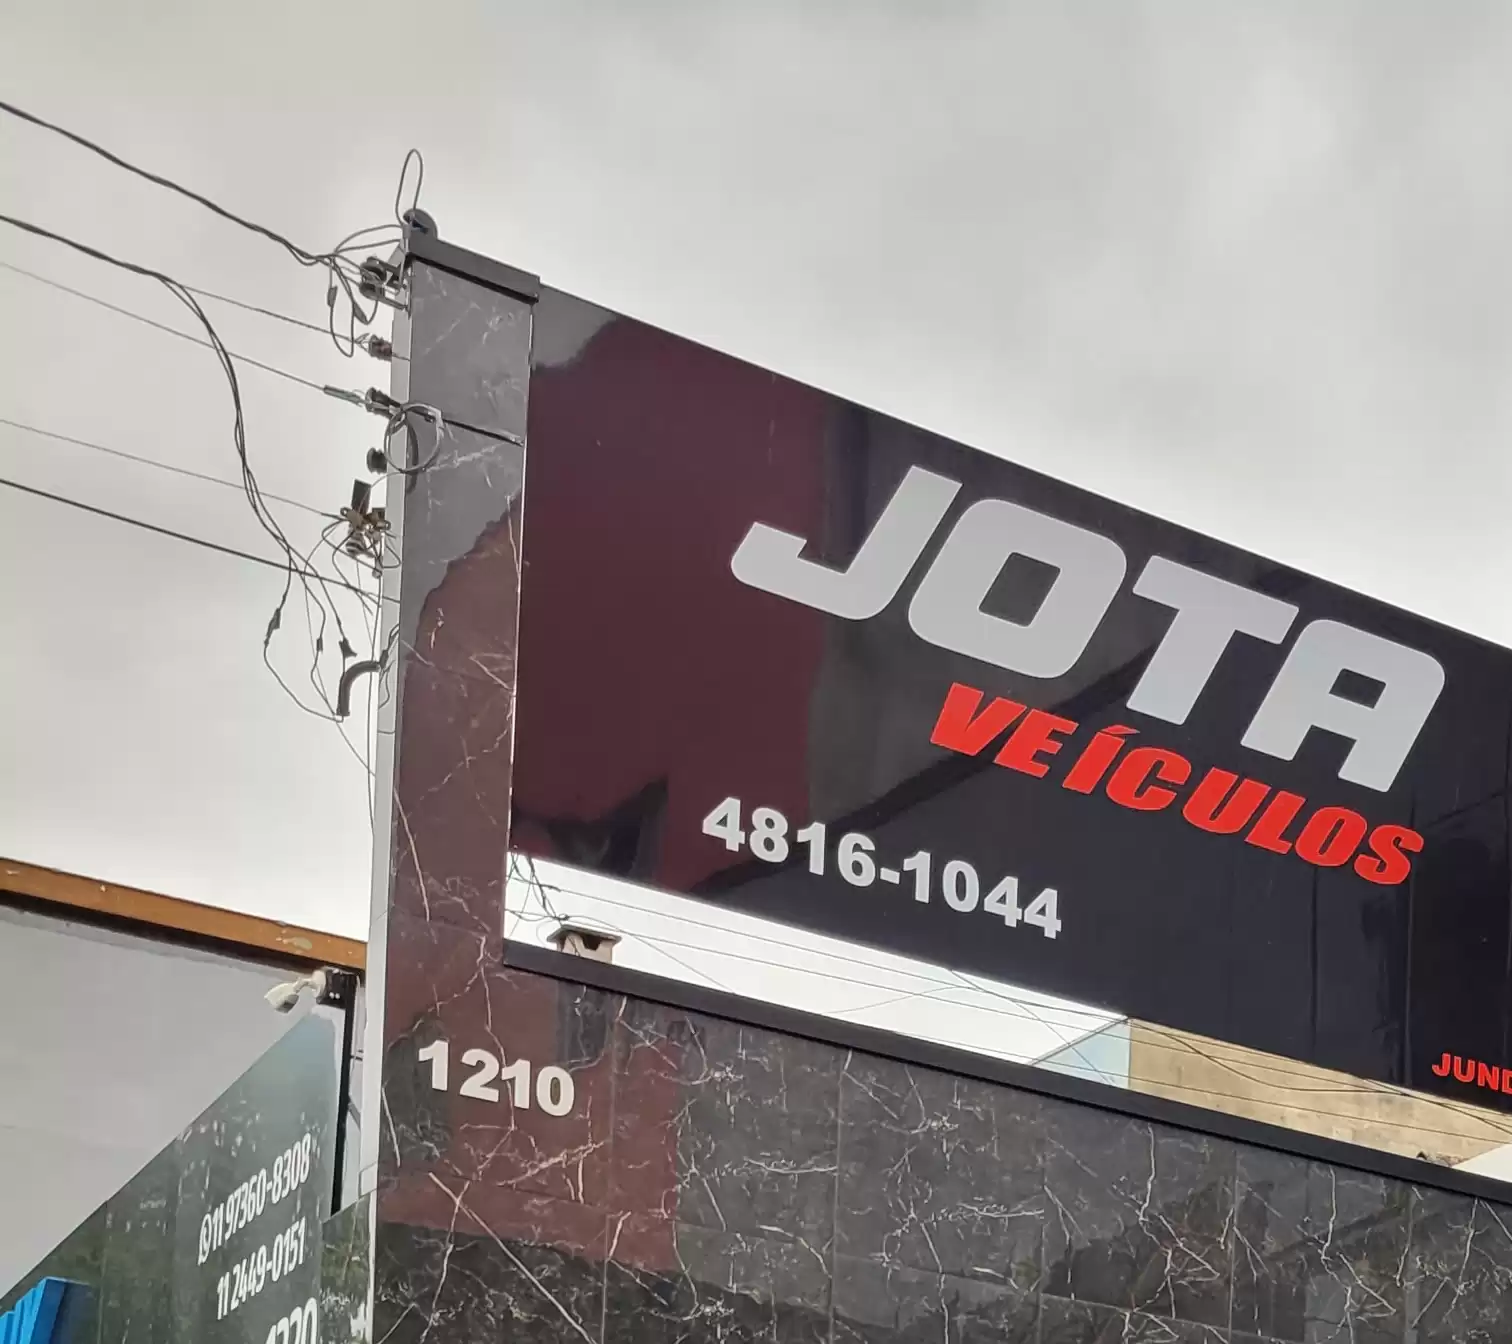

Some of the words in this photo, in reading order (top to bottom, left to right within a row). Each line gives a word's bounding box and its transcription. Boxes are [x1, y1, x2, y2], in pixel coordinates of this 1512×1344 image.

[731, 465, 1446, 793] JOTA
[929, 681, 1425, 886] VEÍCULOS
[702, 796, 1063, 940] 4816-1044
[418, 1039, 575, 1117] 1210
[230, 1216, 306, 1311] 2449-0151
